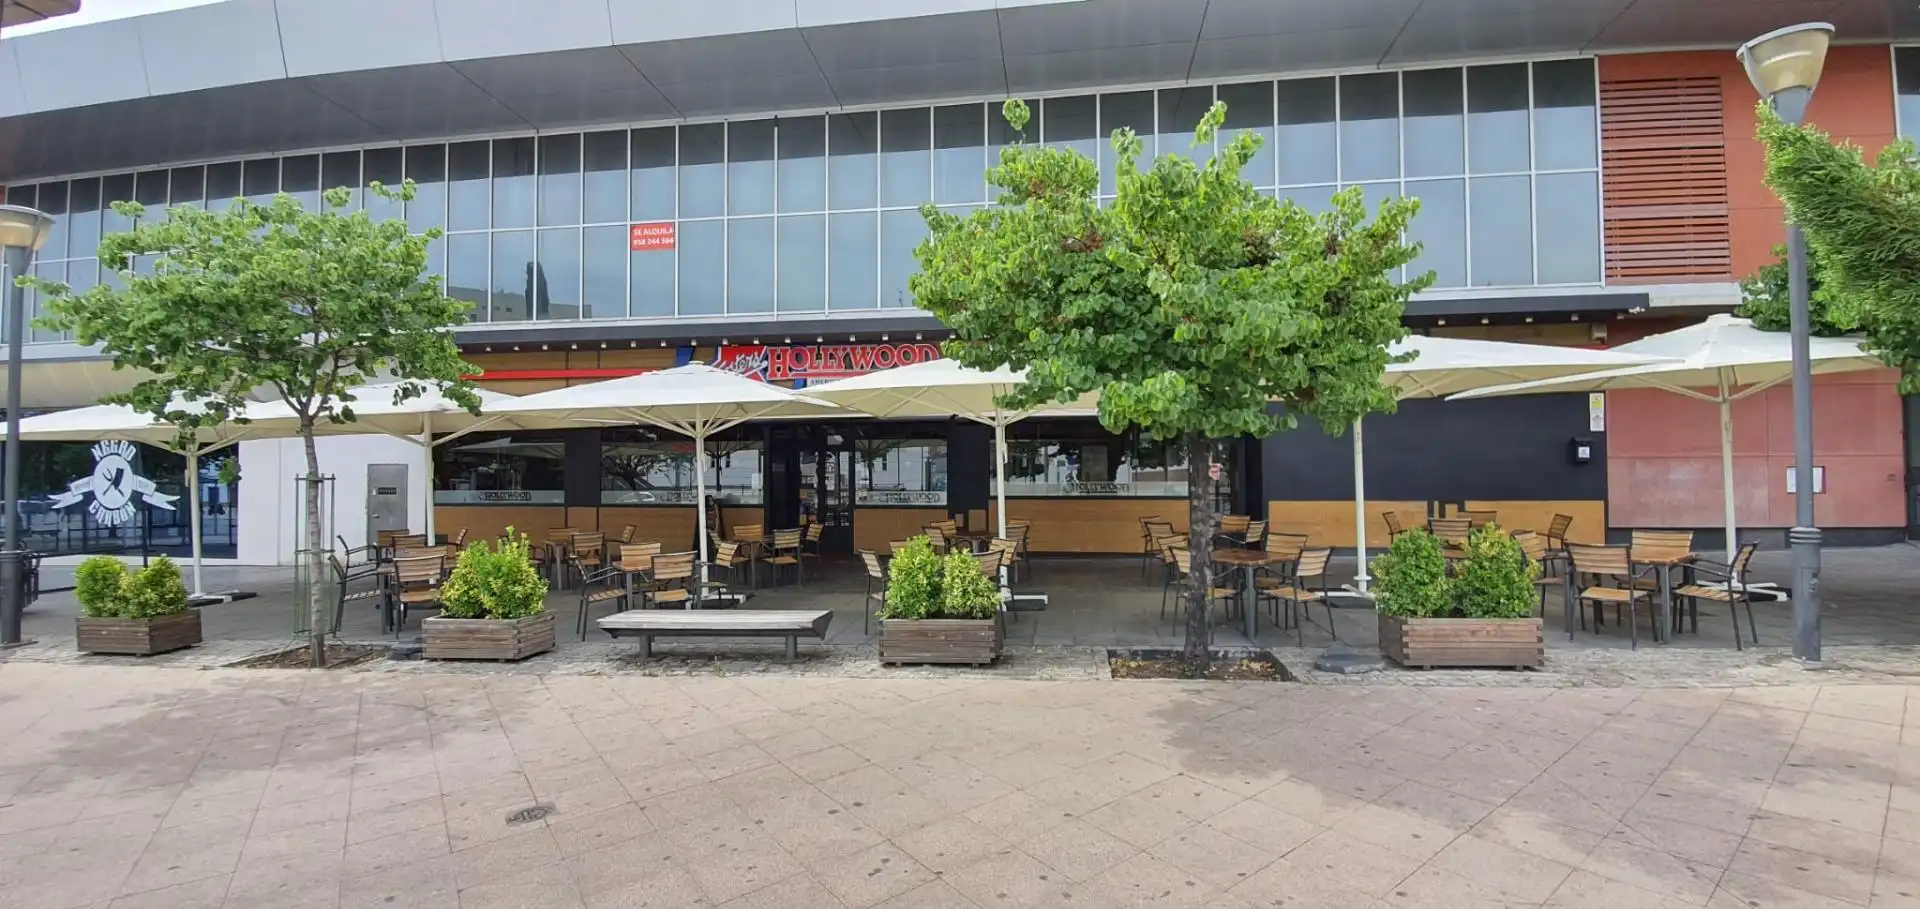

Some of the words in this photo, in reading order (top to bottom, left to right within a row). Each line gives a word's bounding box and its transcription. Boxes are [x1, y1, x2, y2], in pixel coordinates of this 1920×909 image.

[643, 227, 673, 235] ALQUILA
[767, 344, 939, 380] HOLLYWOOD
[91, 440, 136, 461] NEGRO
[89, 499, 136, 527] CARBON
